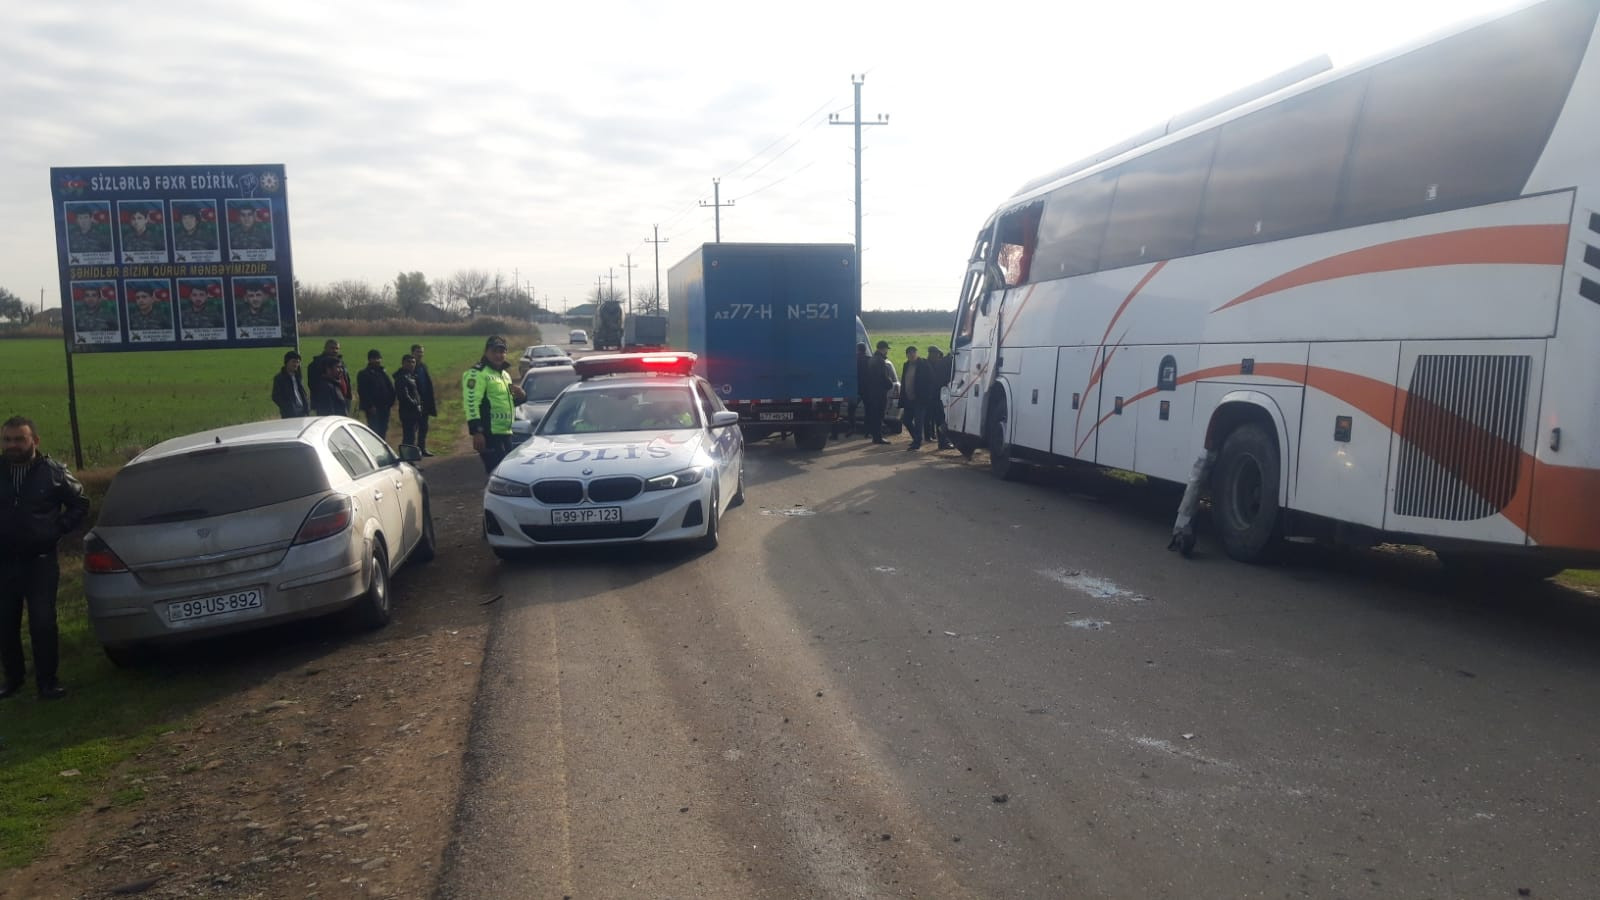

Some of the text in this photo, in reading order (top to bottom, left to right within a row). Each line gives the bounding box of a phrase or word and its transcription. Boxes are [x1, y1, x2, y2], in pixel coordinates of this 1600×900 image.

[91, 172, 151, 191] SİZLƏRLƏ
[155, 175, 187, 190] FƏXR
[123, 264, 149, 277] BİZİM
[521, 443, 673, 466] POLİS
[563, 508, 618, 522] 99-YP-123
[183, 591, 257, 617] 99-US-892
